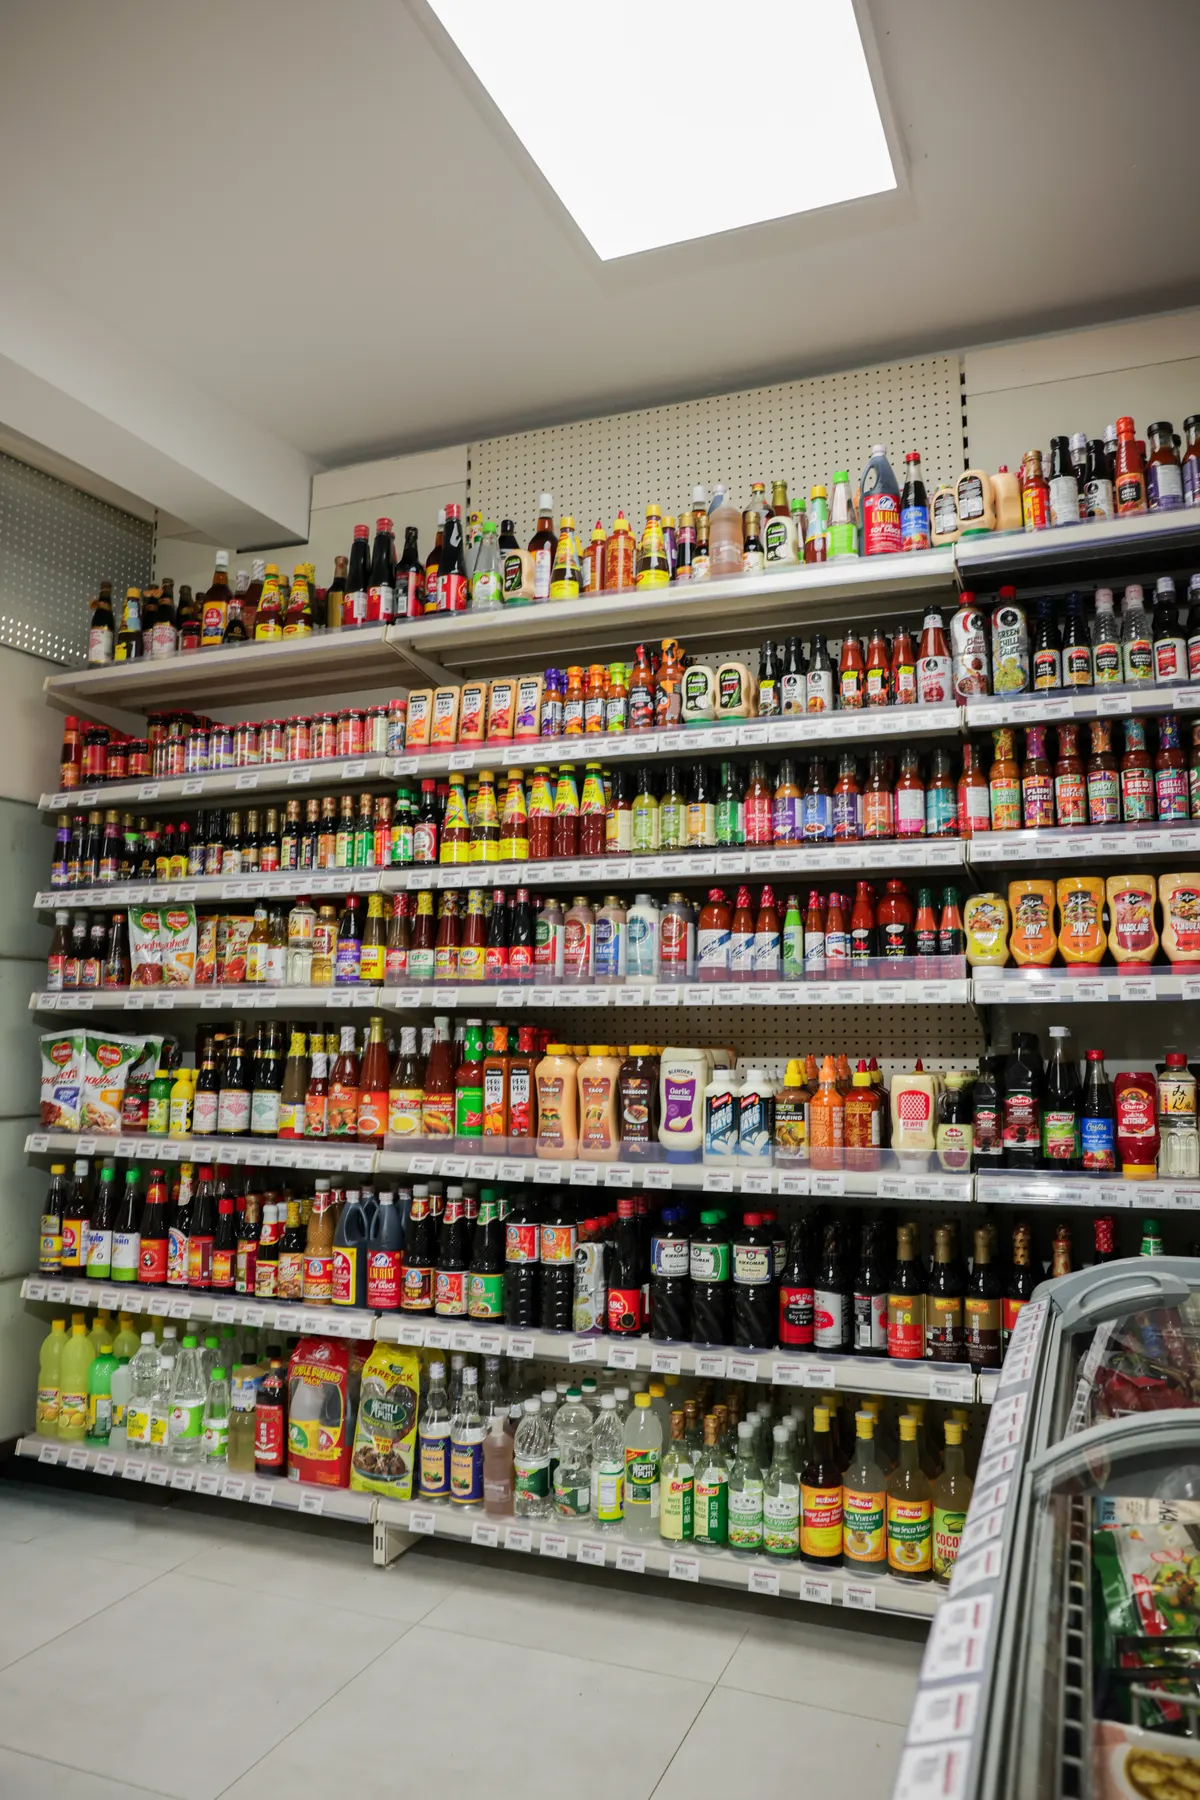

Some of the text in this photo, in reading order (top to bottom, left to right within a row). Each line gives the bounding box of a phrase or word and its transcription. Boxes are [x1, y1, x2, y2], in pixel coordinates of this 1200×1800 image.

[998, 628, 1019, 638] GREEN
[999, 646, 1020, 657] SAUCE
[1160, 780, 1181, 788] CHILLI
[1160, 787, 1182, 795] GARLIC
[1073, 922, 1088, 933] ONY
[670, 1087, 690, 1096] Garlic
[710, 1104, 732, 1120] GARLIC
[710, 1113, 732, 1134] MAYO
[370, 1266, 396, 1280] LAURIAT
[848, 1496, 872, 1508] BUENAS
[856, 1514, 879, 1522] VINEGAR
[896, 1508, 922, 1518] BUENAS
[900, 1526, 916, 1534] SPICED
